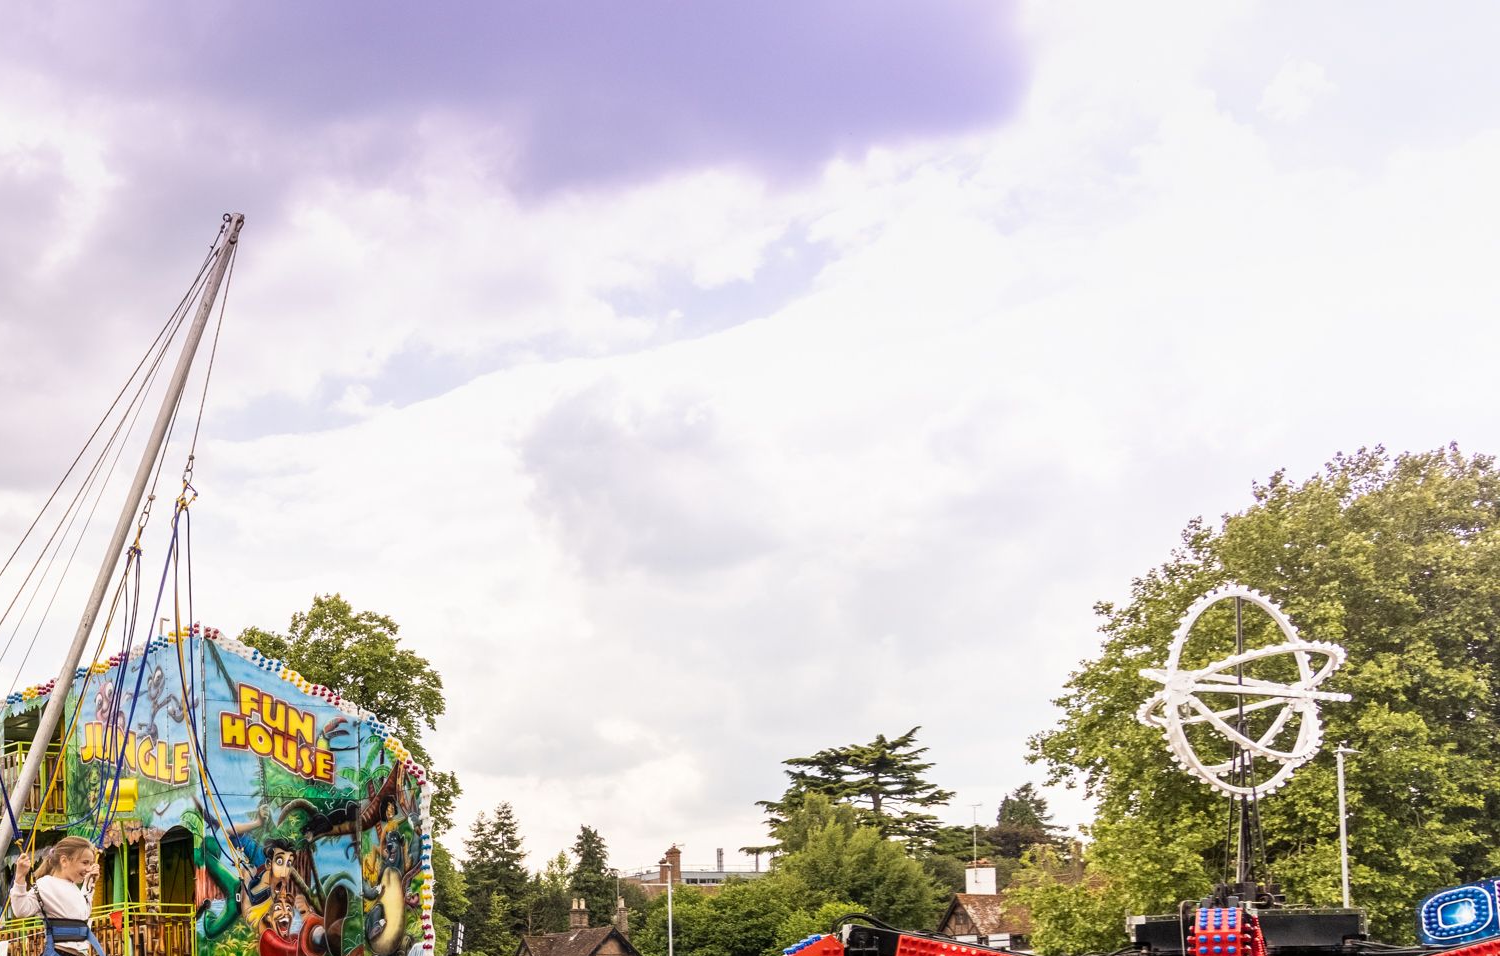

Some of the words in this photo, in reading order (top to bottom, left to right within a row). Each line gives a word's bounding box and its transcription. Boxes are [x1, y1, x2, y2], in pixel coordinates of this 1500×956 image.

[238, 683, 316, 747] FUN
[81, 721, 190, 786] JUNGLE
[220, 711, 335, 785] HOUSE
